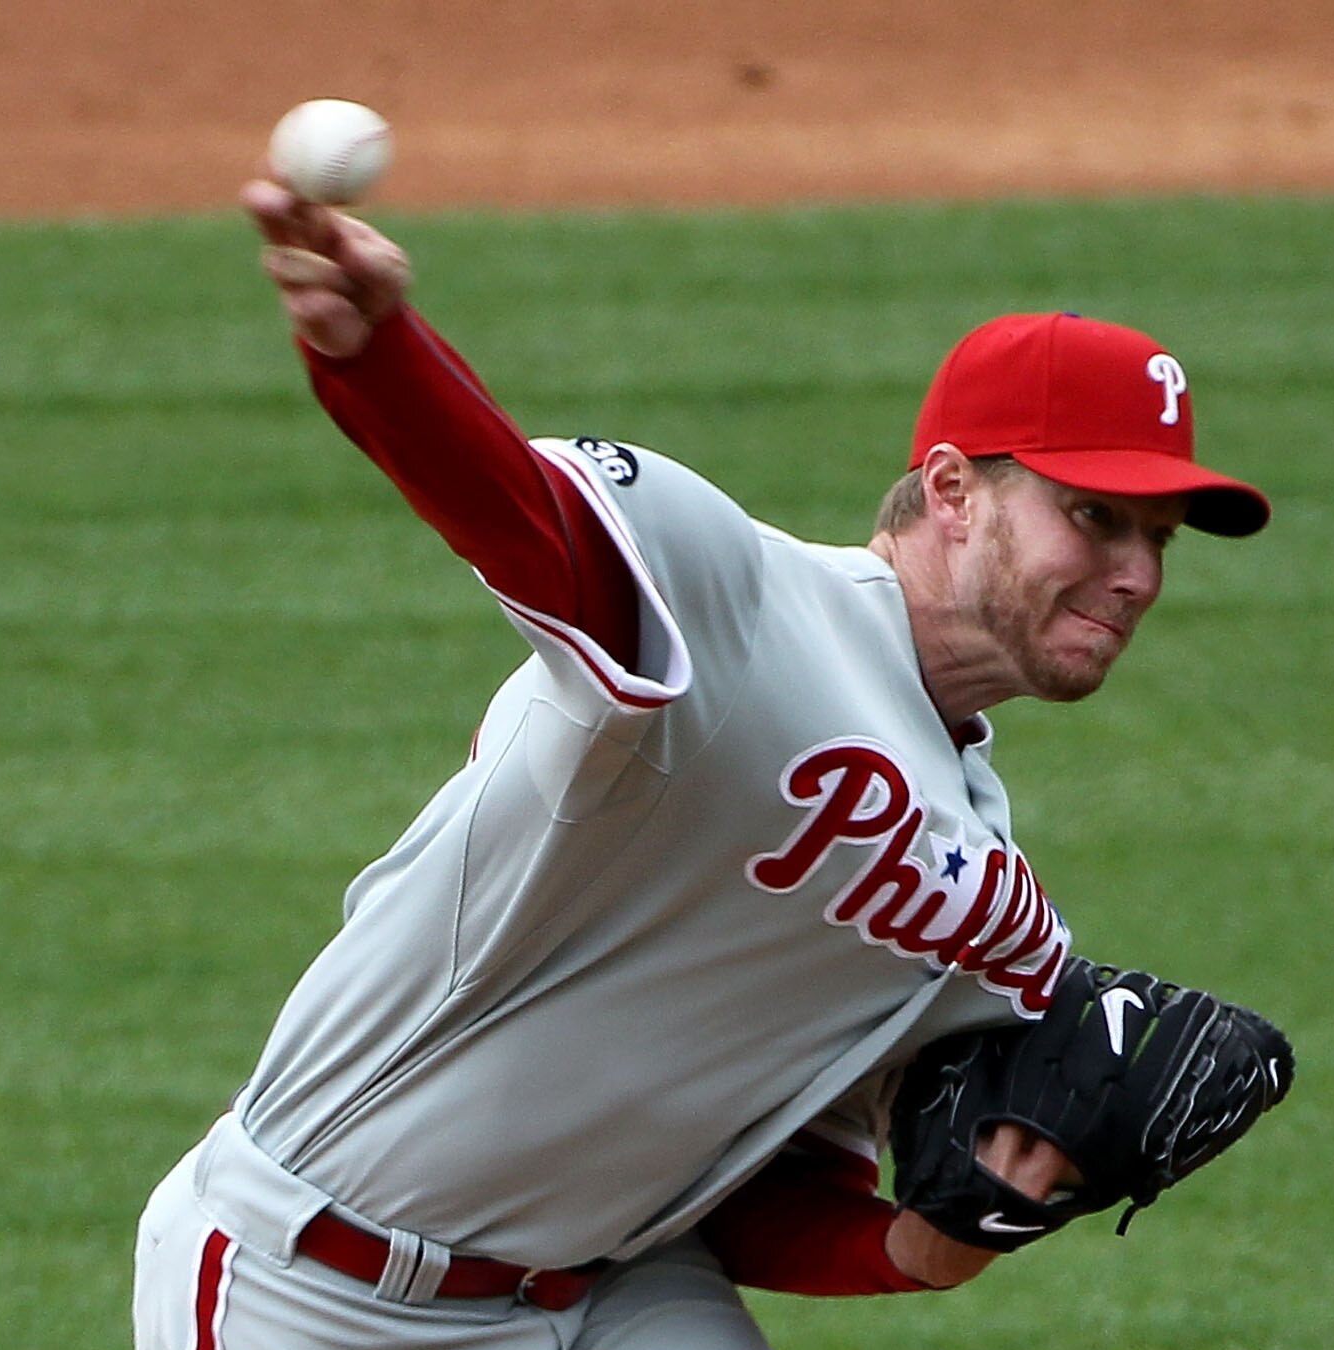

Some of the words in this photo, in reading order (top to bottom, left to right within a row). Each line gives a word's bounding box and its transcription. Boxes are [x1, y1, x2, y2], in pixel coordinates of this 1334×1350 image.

[1147, 353, 1187, 425] P
[581, 440, 633, 481] 36
[747, 737, 1069, 1018] Philli
